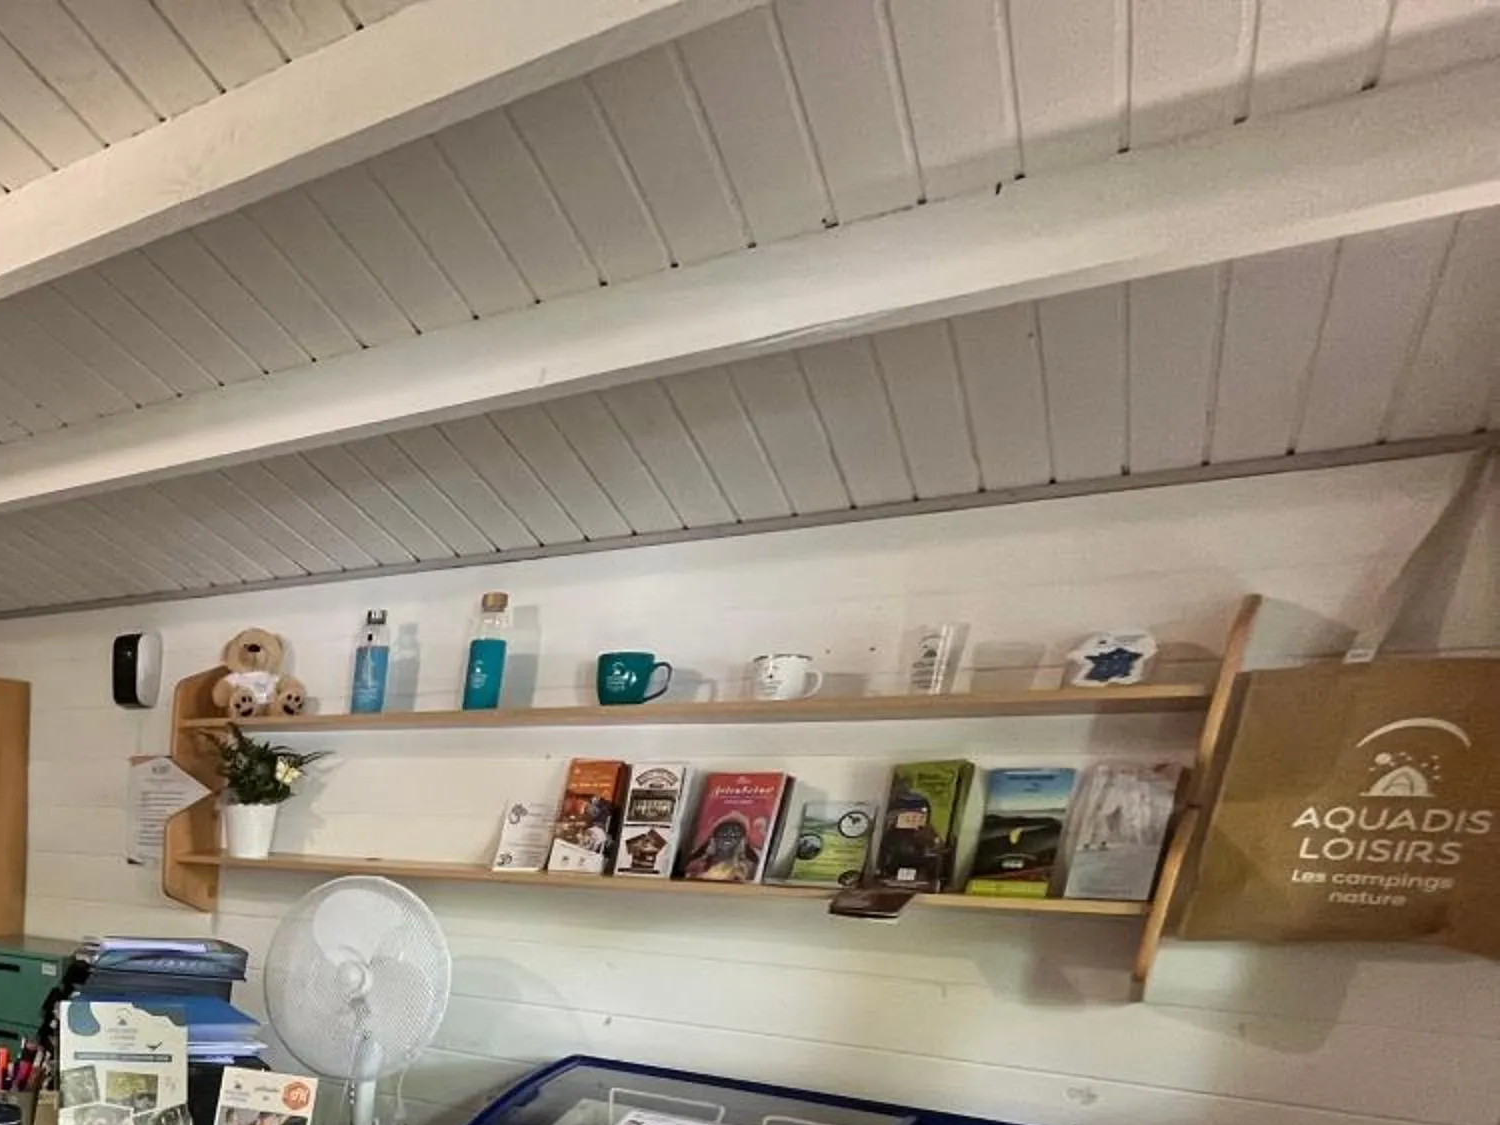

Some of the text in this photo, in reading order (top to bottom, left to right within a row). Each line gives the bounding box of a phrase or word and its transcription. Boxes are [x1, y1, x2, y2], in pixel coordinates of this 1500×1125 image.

[1291, 805, 1493, 834] AQUADIS
[1299, 837, 1463, 865] LOISIRS
[1292, 868, 1455, 893] Les campings
[1328, 889, 1407, 907] nature
